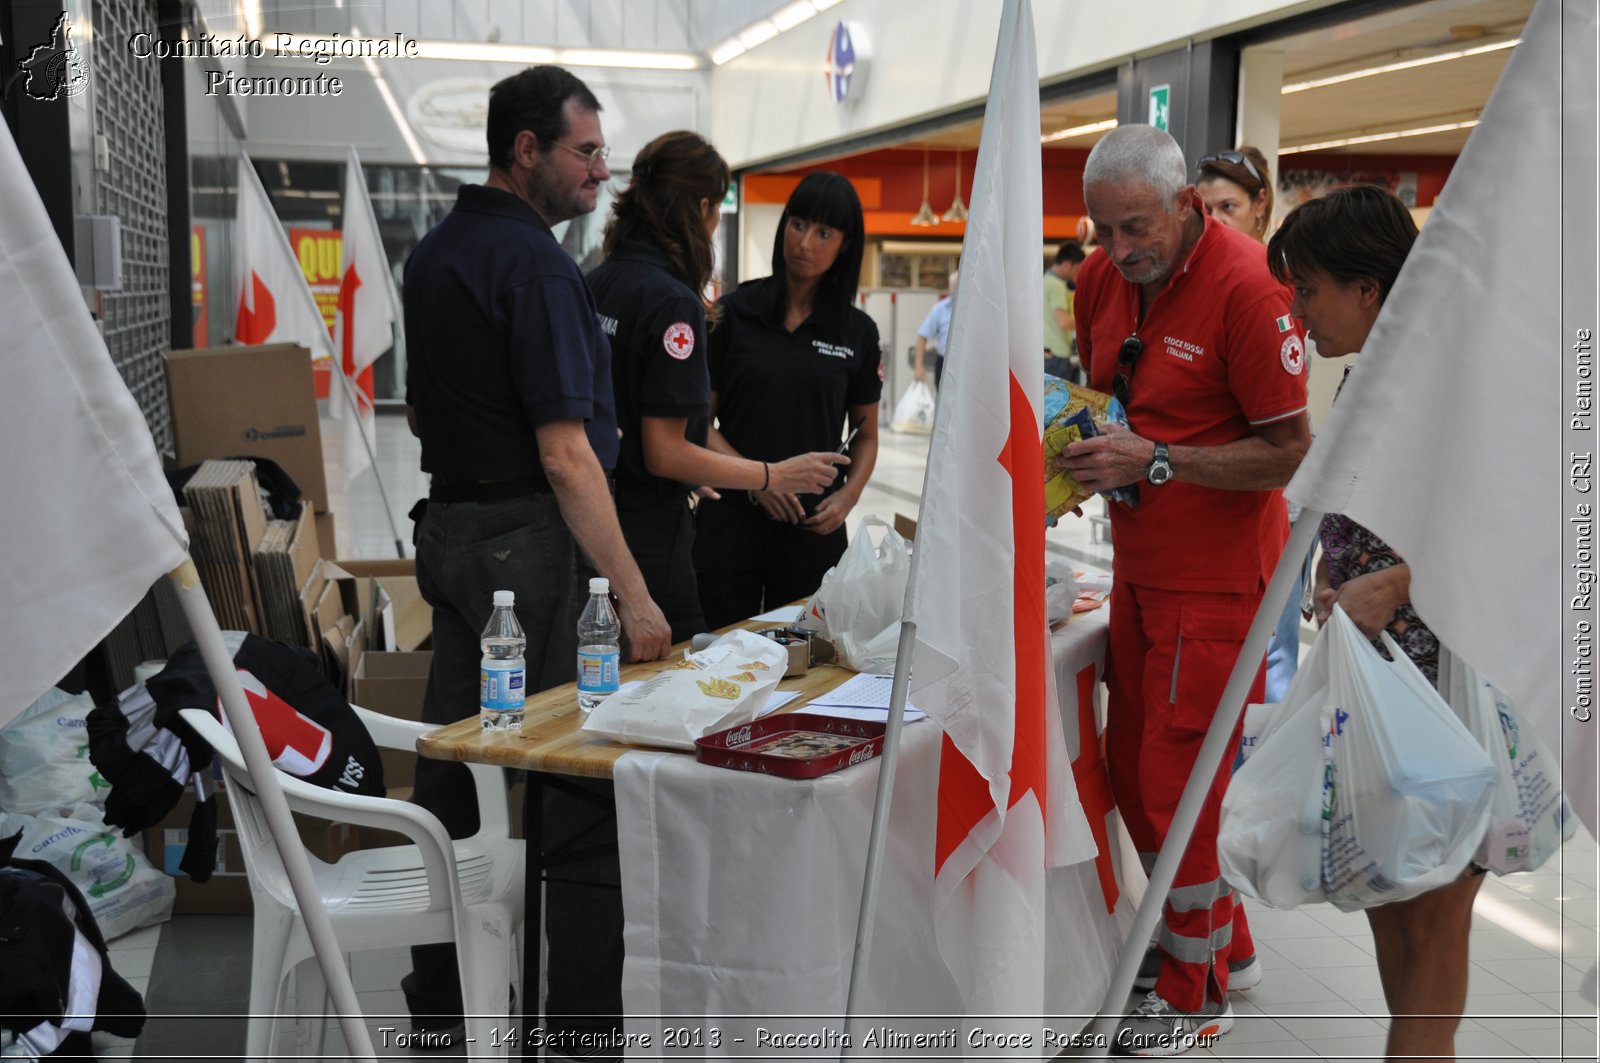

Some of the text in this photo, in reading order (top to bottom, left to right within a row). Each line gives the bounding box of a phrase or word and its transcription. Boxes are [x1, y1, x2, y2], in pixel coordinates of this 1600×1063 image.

[812, 340, 833, 350] CROCE
[1163, 336, 1204, 356] CROCE ROSSA
[1166, 346, 1193, 362] ITALIANA
